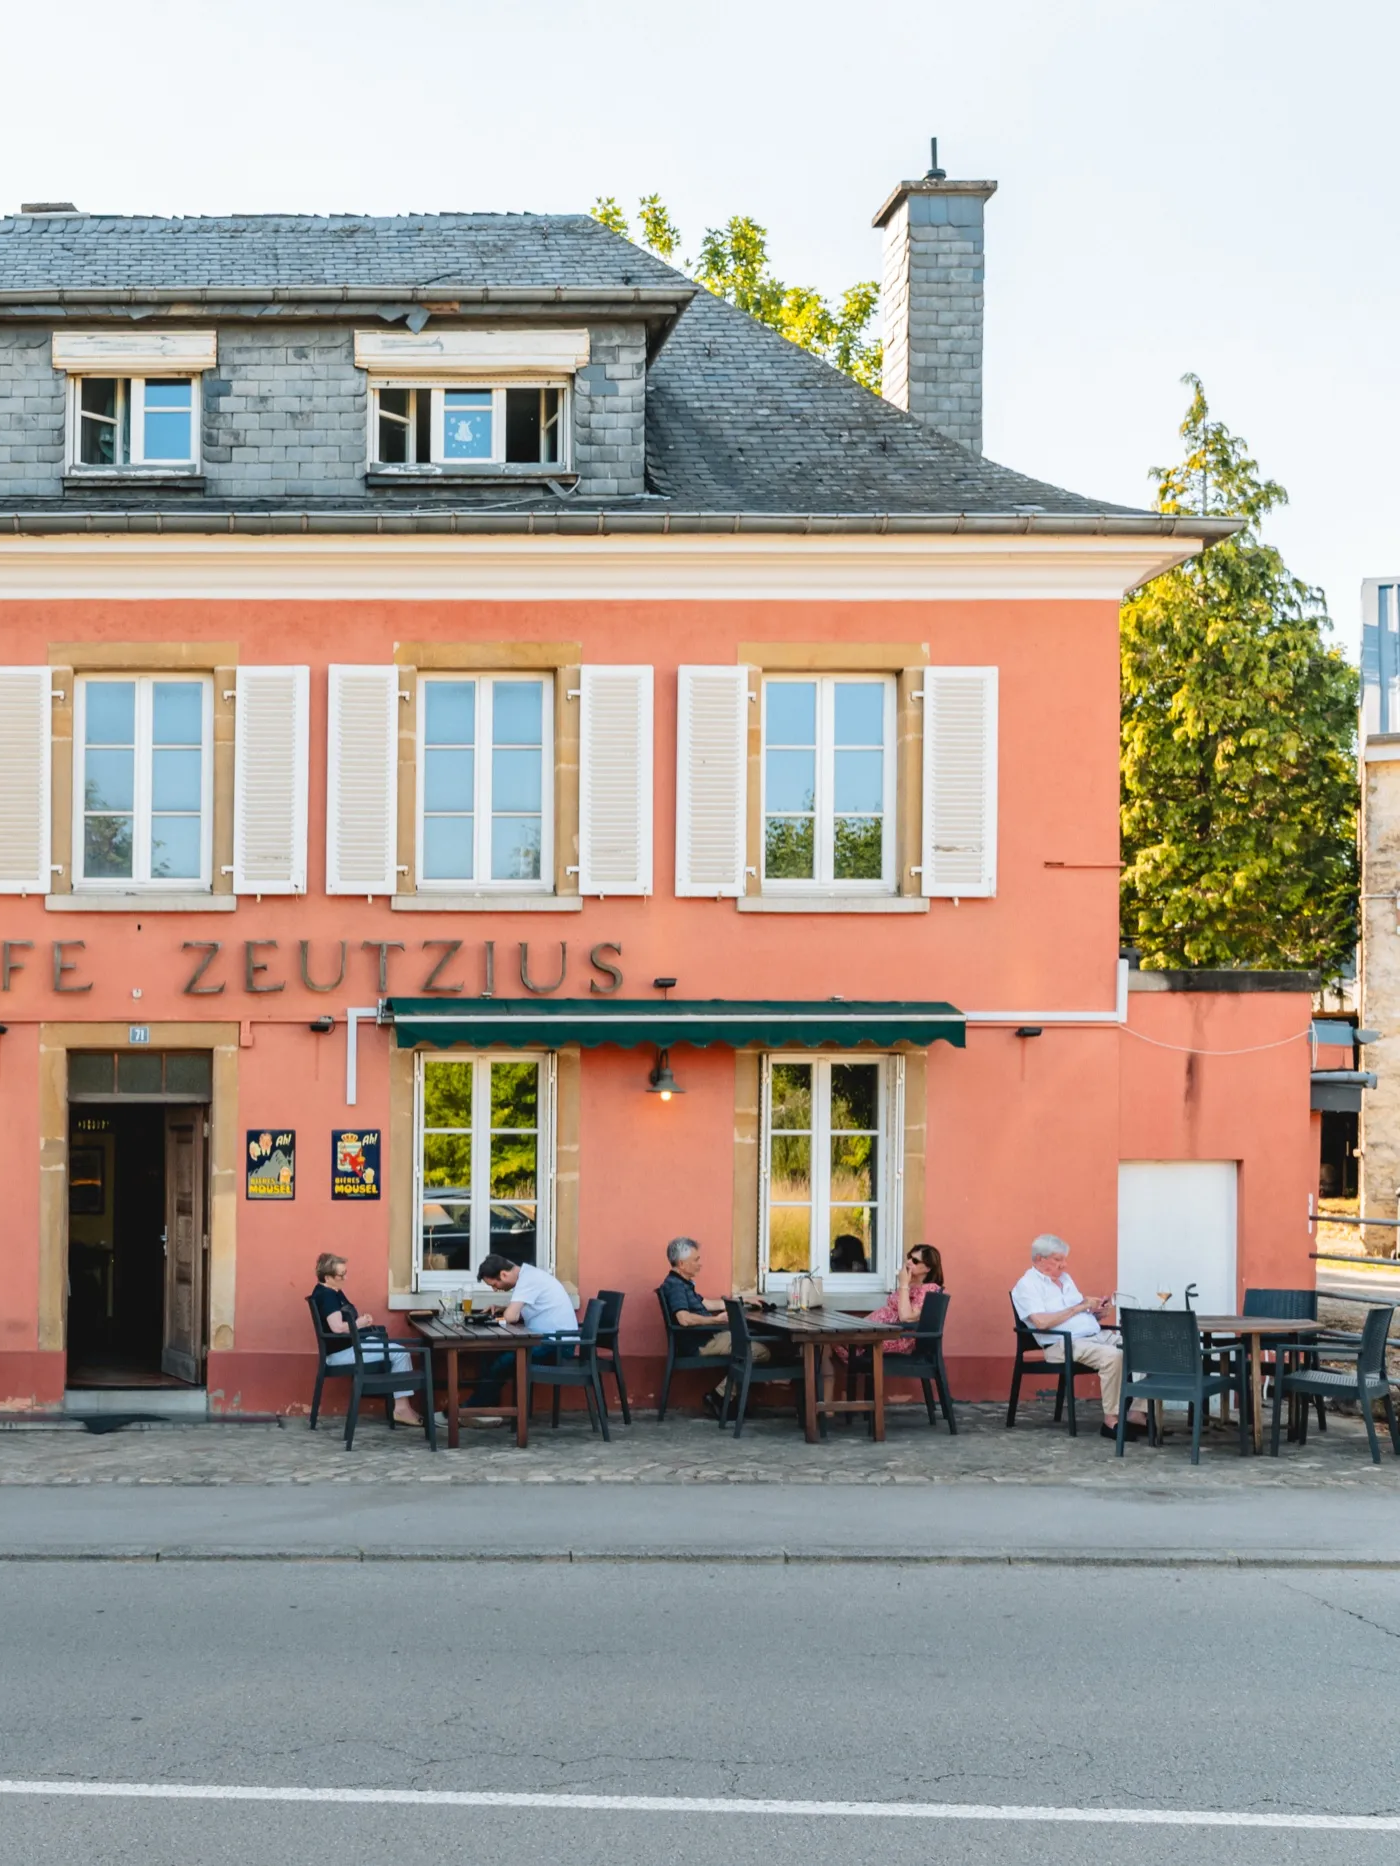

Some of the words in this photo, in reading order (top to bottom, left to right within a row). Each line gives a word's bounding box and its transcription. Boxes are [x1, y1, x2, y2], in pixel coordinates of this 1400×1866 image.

[180, 939, 624, 994] ZEUTZIUS
[135, 1029, 145, 1041] 71
[249, 1184, 292, 1195] MOUSEL
[334, 1184, 379, 1194] MOUSEL
